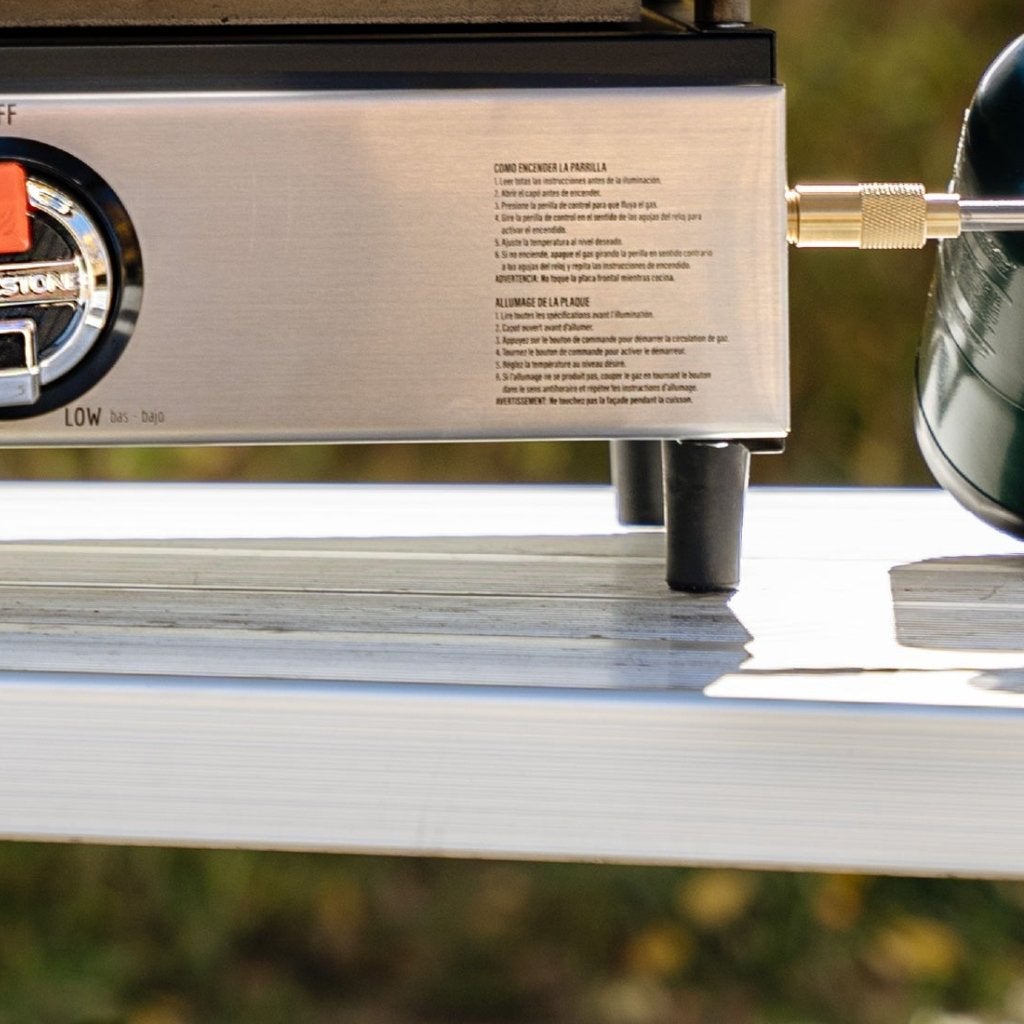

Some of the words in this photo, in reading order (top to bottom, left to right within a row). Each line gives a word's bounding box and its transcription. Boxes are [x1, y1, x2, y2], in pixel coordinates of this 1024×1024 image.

[495, 297, 535, 308] ALLUMAGE
[537, 296, 546, 308] DE
[548, 296, 558, 308] LA
[560, 296, 589, 308] PLAQUE
[64, 407, 102, 428] LOW
[109, 410, 129, 424] bas
[141, 409, 166, 425] bajo
